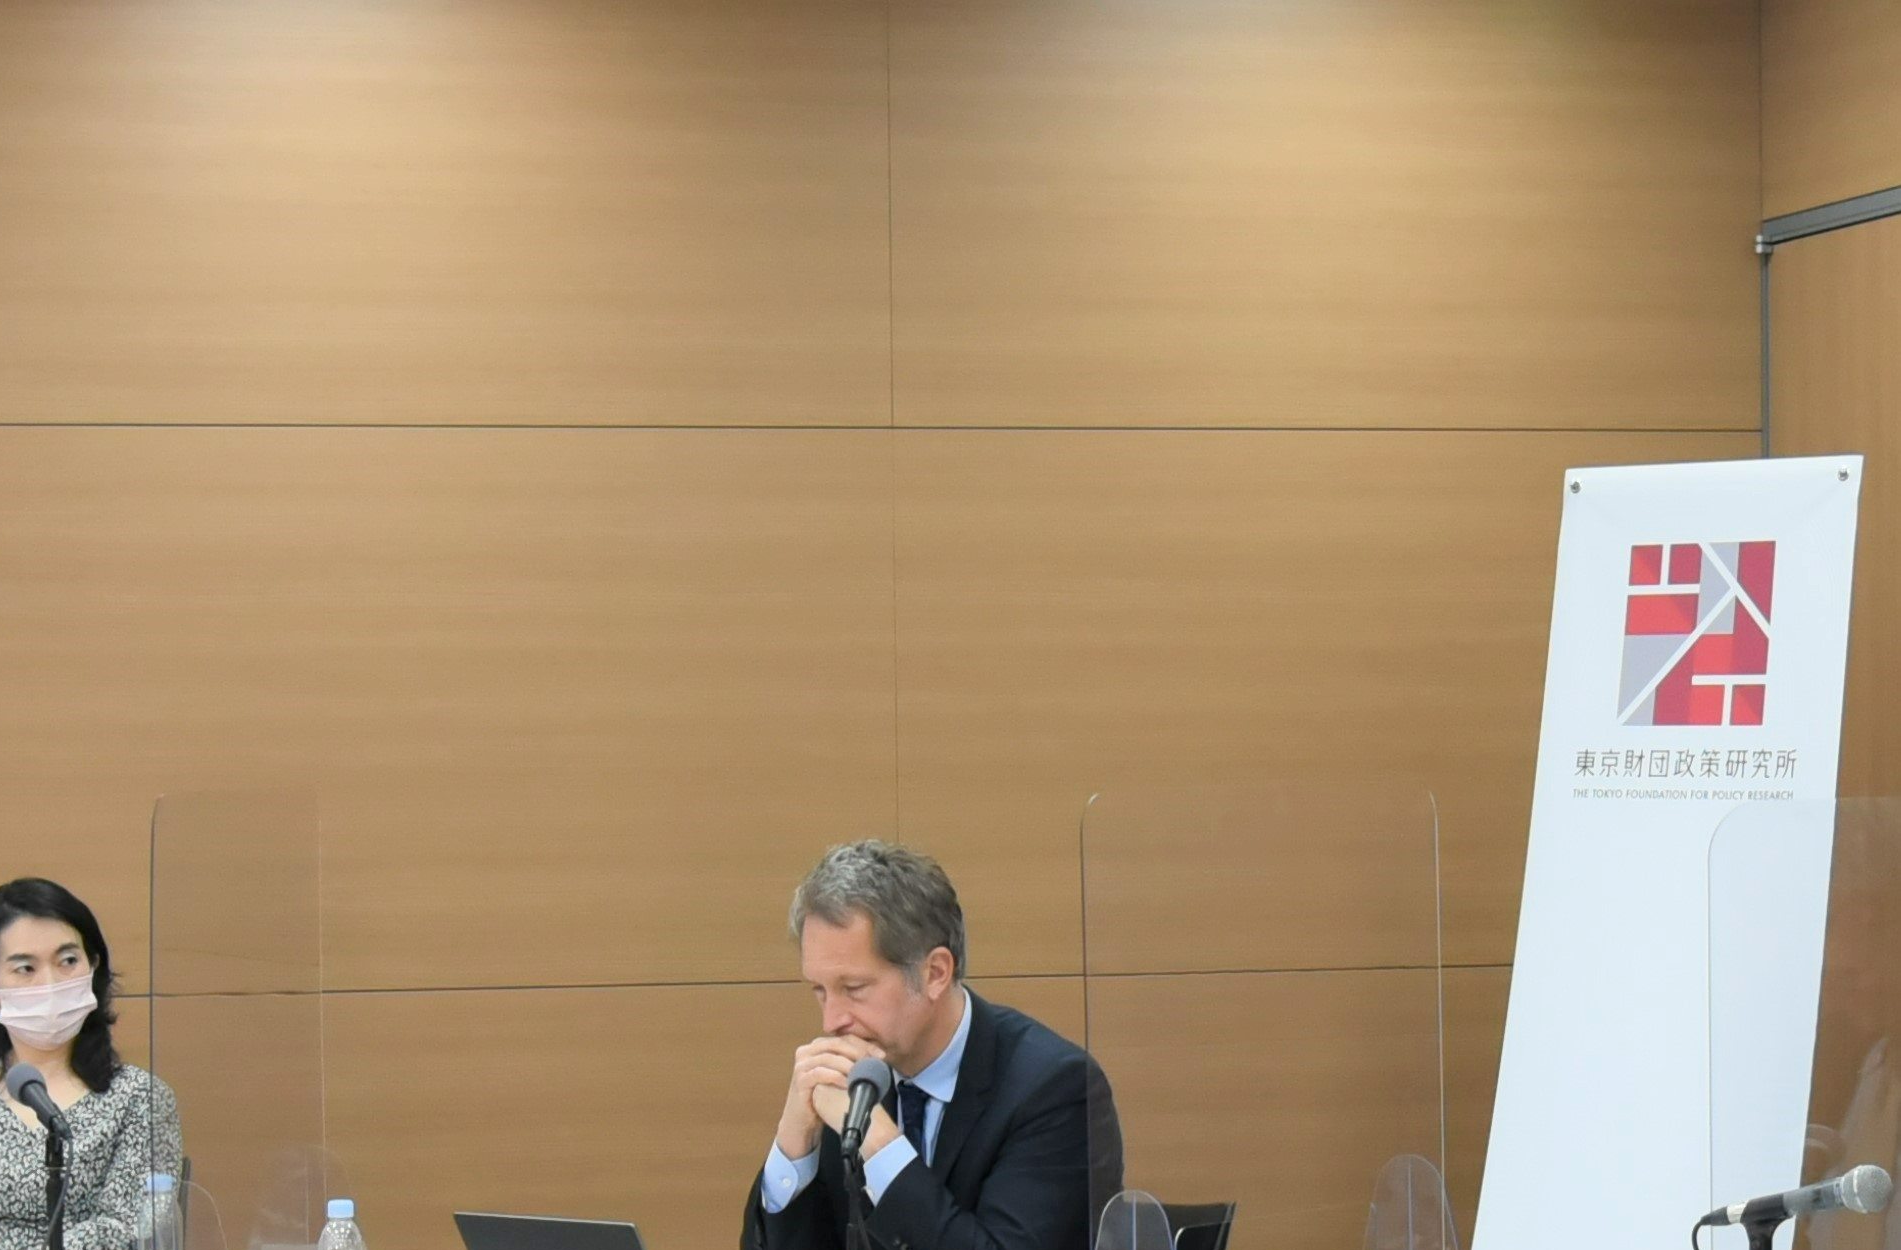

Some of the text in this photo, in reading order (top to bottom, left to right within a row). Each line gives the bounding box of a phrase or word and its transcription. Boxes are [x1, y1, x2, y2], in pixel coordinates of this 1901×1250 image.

[1574, 748, 1796, 779] 東京財団政策研究所
[1573, 788, 1794, 801] THE TOKYO FOUNDATION FOR POLICY RESEARCH
